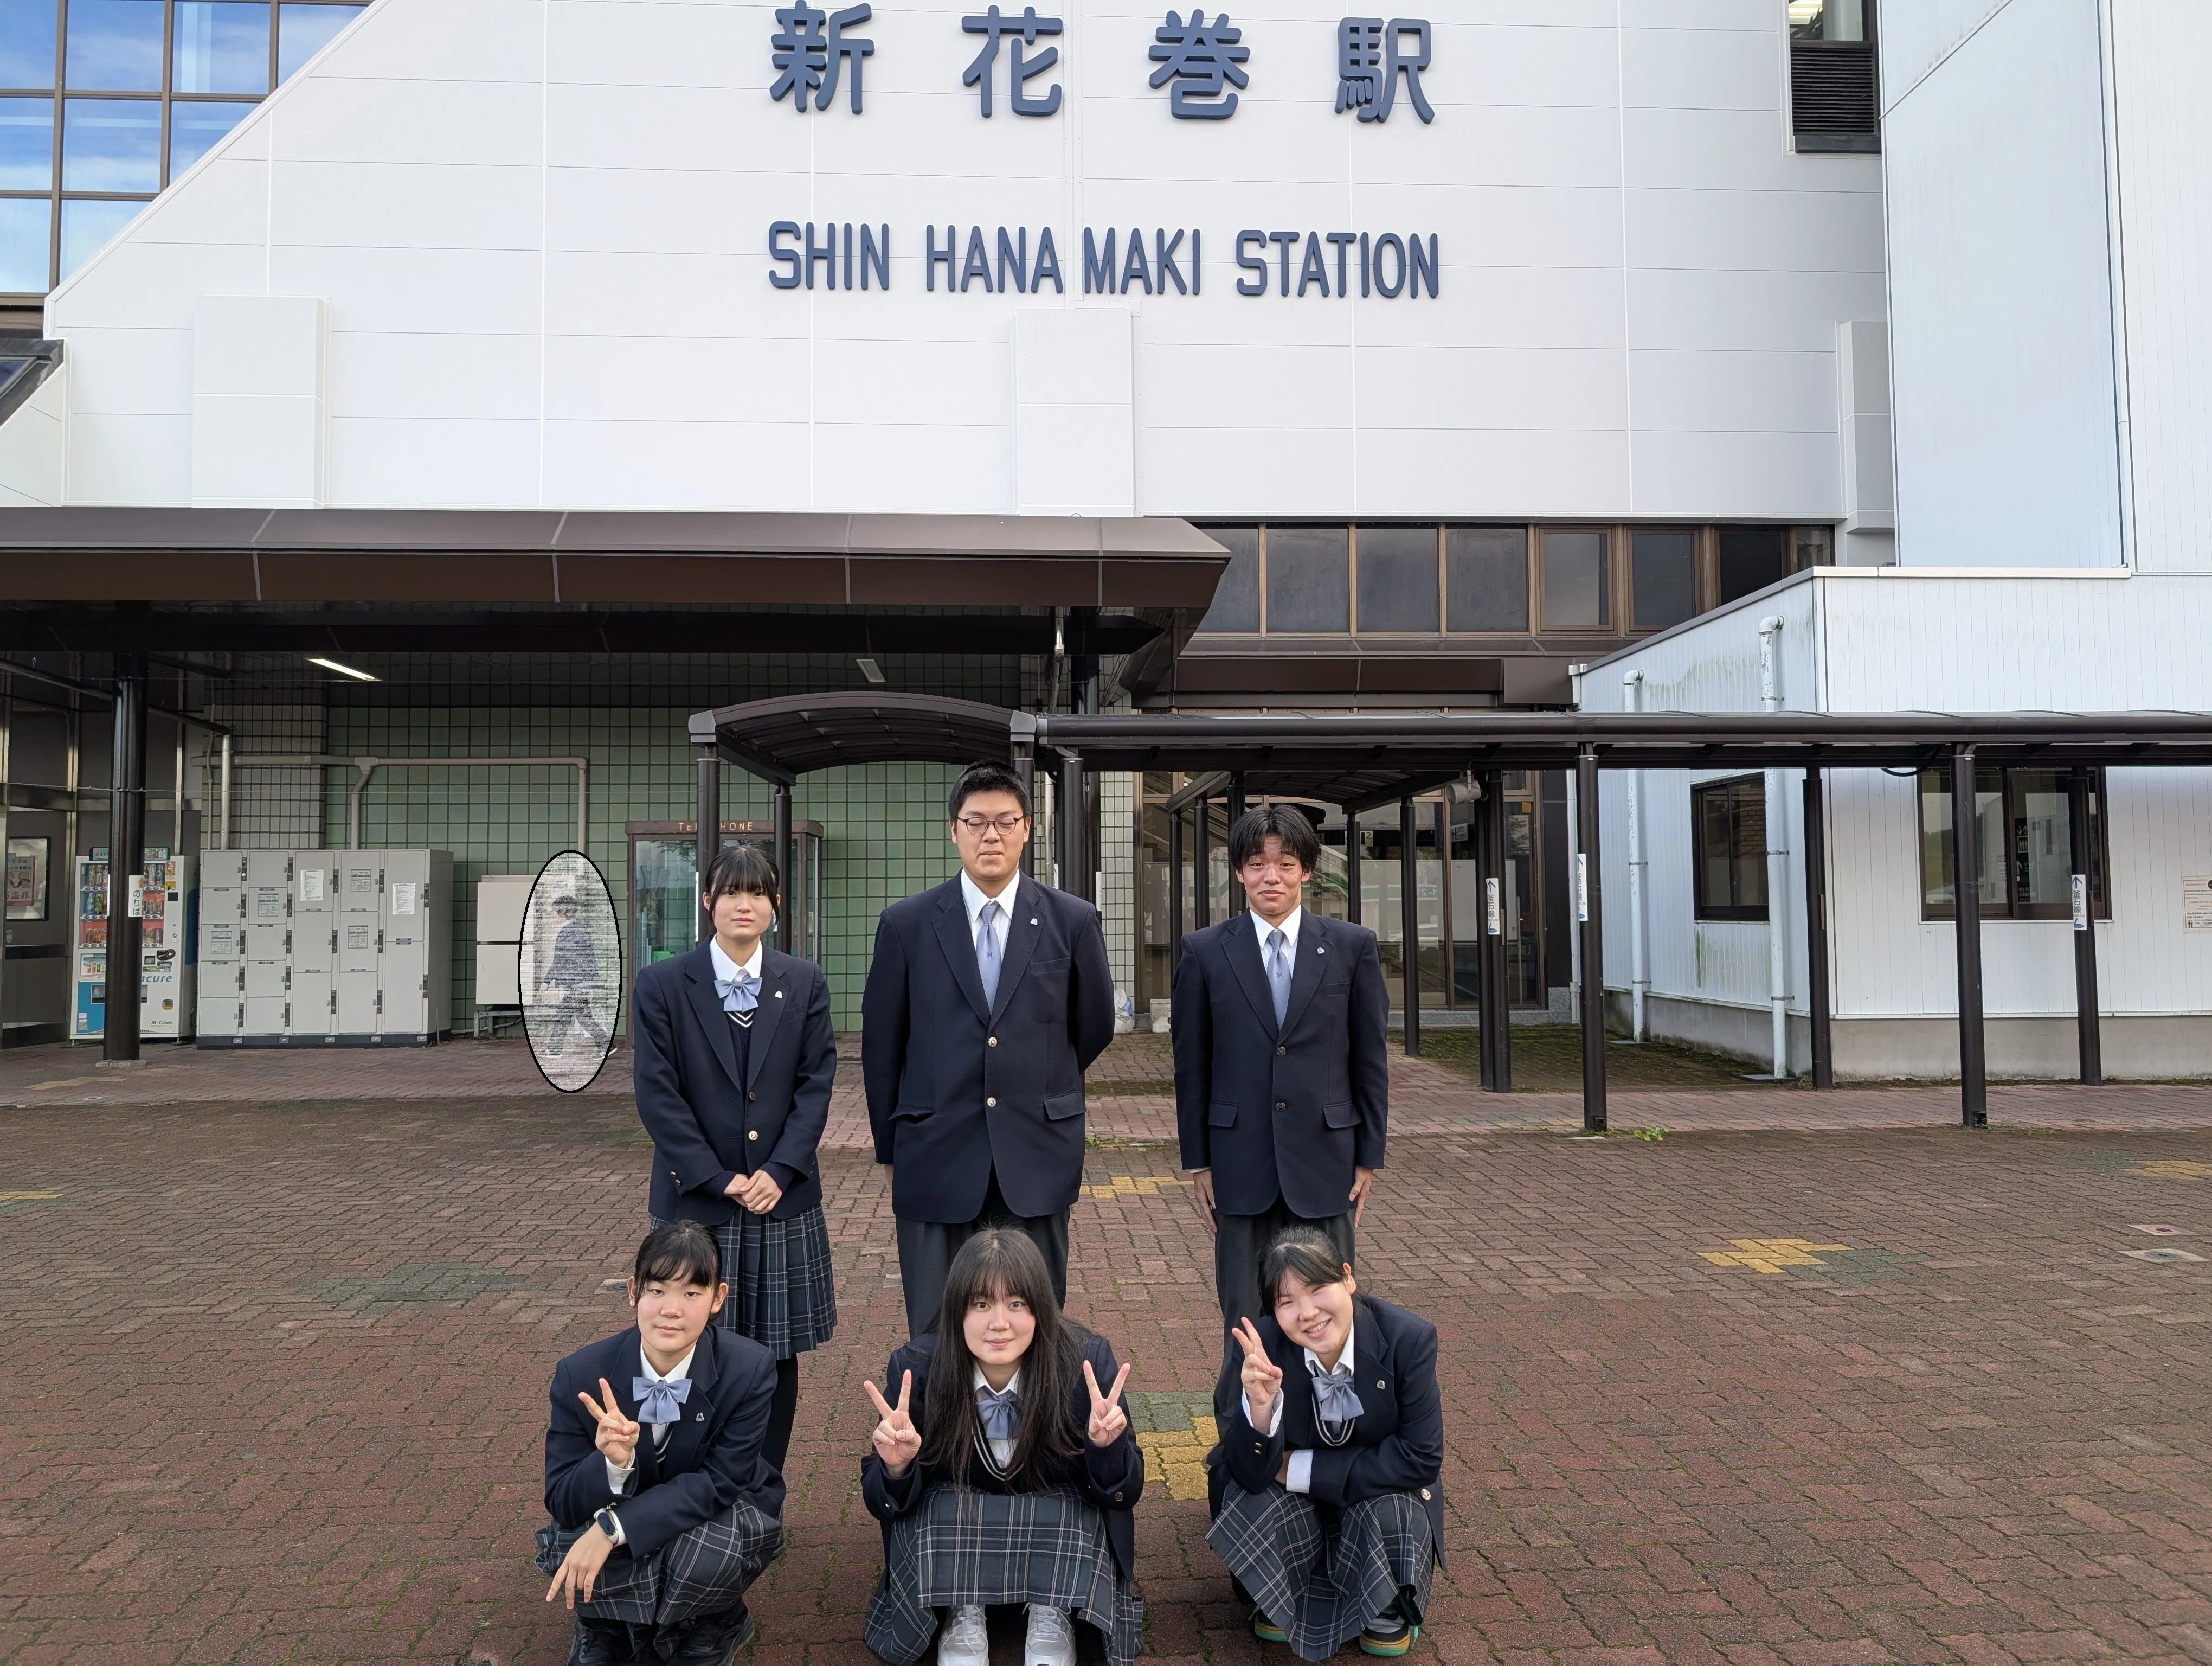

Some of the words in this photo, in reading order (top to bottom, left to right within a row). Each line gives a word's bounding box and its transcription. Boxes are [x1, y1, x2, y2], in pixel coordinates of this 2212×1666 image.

[770, 0, 1435, 124] 新花巻駅
[769, 221, 890, 291] SHIN
[1236, 229, 1439, 299] STATION
[679, 822, 753, 831] TEHONE
[2073, 890, 2081, 913] 釜石線
